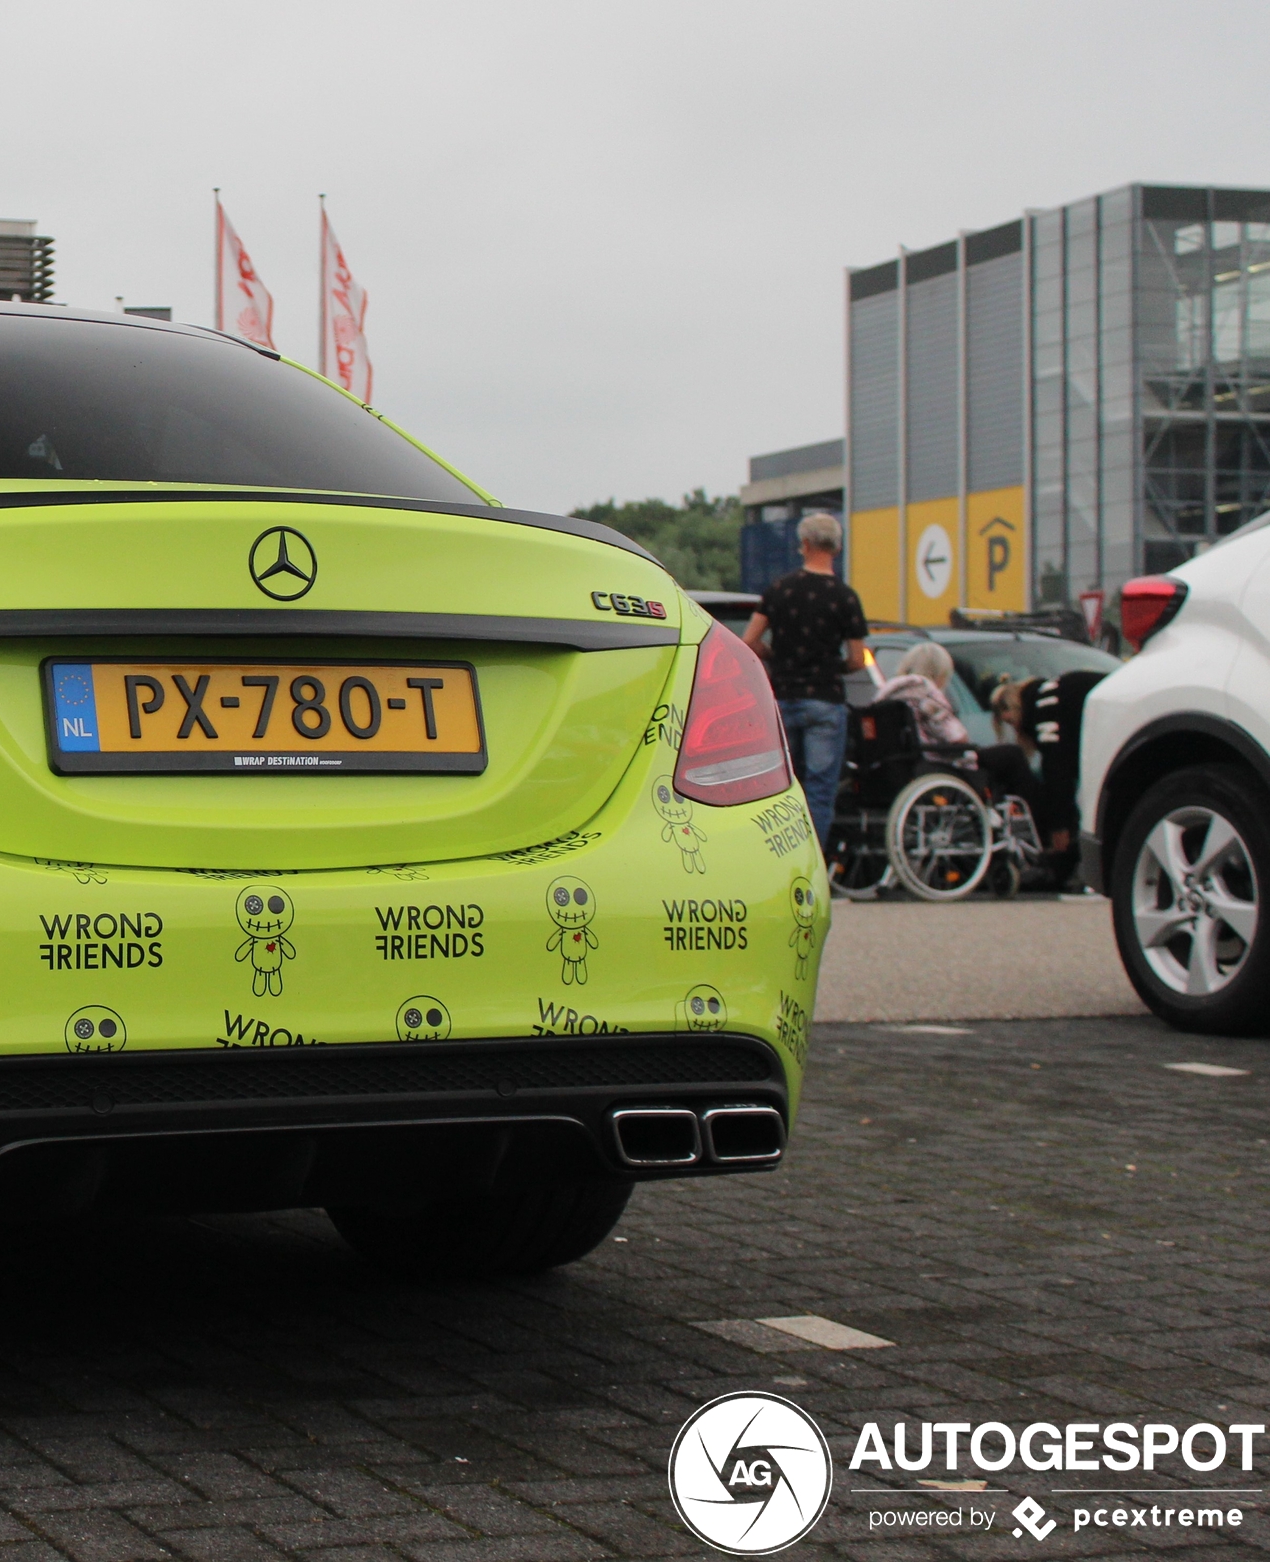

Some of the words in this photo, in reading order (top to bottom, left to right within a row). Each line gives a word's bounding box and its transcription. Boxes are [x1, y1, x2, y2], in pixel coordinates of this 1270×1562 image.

[124, 674, 444, 740] PX-780-T
[62, 718, 93, 738] NL
[242, 756, 265, 766] WRAP
[750, 795, 803, 834] WRONG
[375, 903, 484, 932] WRONG
[662, 899, 747, 923] WRONG
[40, 912, 163, 940] WRONG
[664, 926, 748, 951] FRIENDS
[40, 941, 163, 970] FRIENDS
[375, 932, 484, 961] FRIENDS
